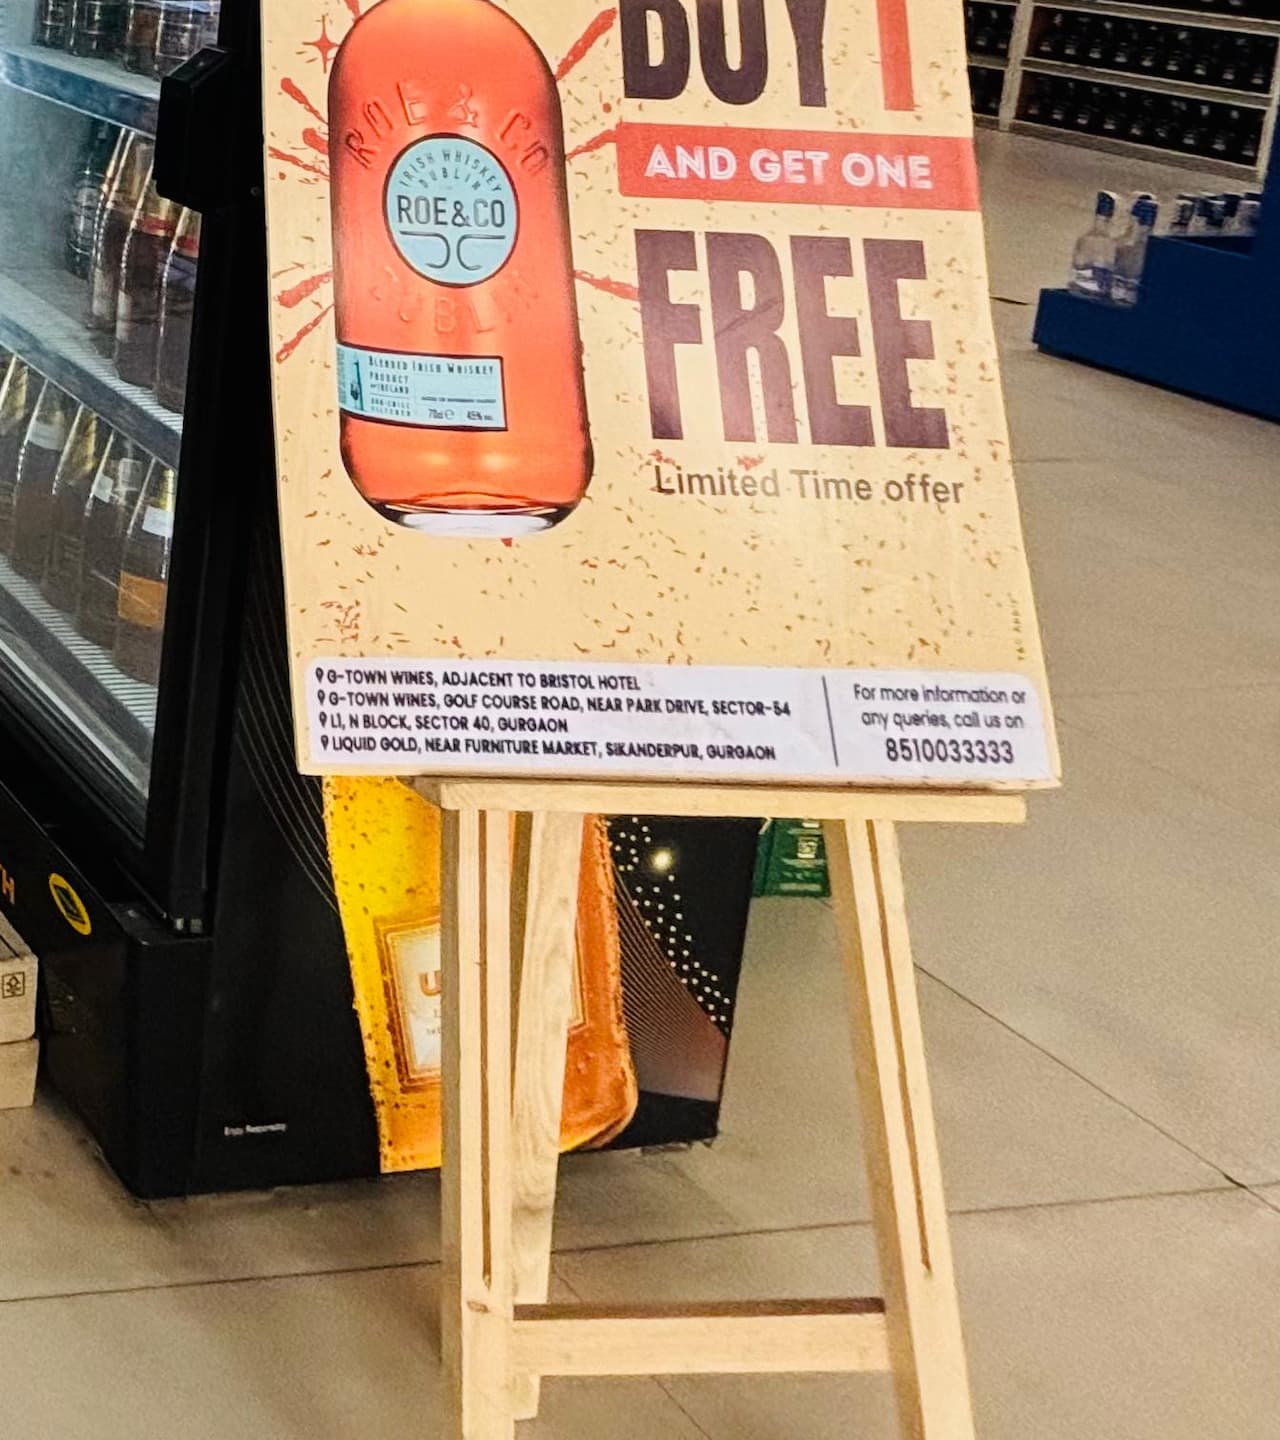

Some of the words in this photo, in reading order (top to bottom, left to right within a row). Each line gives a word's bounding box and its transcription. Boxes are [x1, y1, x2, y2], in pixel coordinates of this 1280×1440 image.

[399, 152, 435, 189] IRISH
[443, 150, 503, 192] WHISKEY
[418, 167, 482, 191] DUBLIN
[645, 145, 736, 179] AND
[752, 150, 828, 184] GET
[842, 153, 933, 189] ONE
[397, 194, 506, 228] ROE&CO
[634, 229, 950, 449] FREE
[654, 464, 780, 501] Limited
[793, 468, 872, 501] Time
[883, 473, 964, 504] offer
[327, 669, 387, 685] G-TOWN
[391, 671, 438, 687] WINES,
[442, 671, 513, 687] ADJACENT
[517, 673, 536, 687] TO
[540, 674, 594, 689] BRISTOL
[598, 675, 641, 690] HOTEL
[329, 691, 389, 707] G-TOWN
[393, 693, 440, 710] WINES,
[443, 694, 478, 709] GOLF
[482, 694, 537, 710] COURSE
[541, 696, 584, 713] ROAD,
[587, 697, 622, 712] NEAR
[626, 697, 662, 713] PARK
[665, 699, 709, 717] DRIVE,
[712, 700, 791, 717] SECTOR-54
[854, 683, 876, 700] For
[880, 687, 918, 701] more
[922, 685, 1008, 703] information
[1011, 691, 1026, 704] or
[349, 714, 359, 729] N
[363, 714, 412, 731] BLOCK,
[415, 715, 469, 730] SECTOR
[473, 716, 494, 733] 40,
[498, 717, 568, 733] GURGAON
[861, 712, 888, 730] any
[893, 710, 951, 731] queries,
[954, 711, 980, 727] call
[984, 715, 1001, 728] us
[1005, 715, 1024, 728] on
[332, 736, 376, 753] LIQUID
[380, 737, 421, 754] GOLD,
[425, 738, 461, 753] NEAR
[465, 738, 539, 755] FURNITURE
[542, 740, 602, 758] MARKET,
[606, 742, 703, 760] SIKANDERPUR,
[706, 744, 776, 760] GURGAON
[886, 738, 1014, 764] 8510033333
